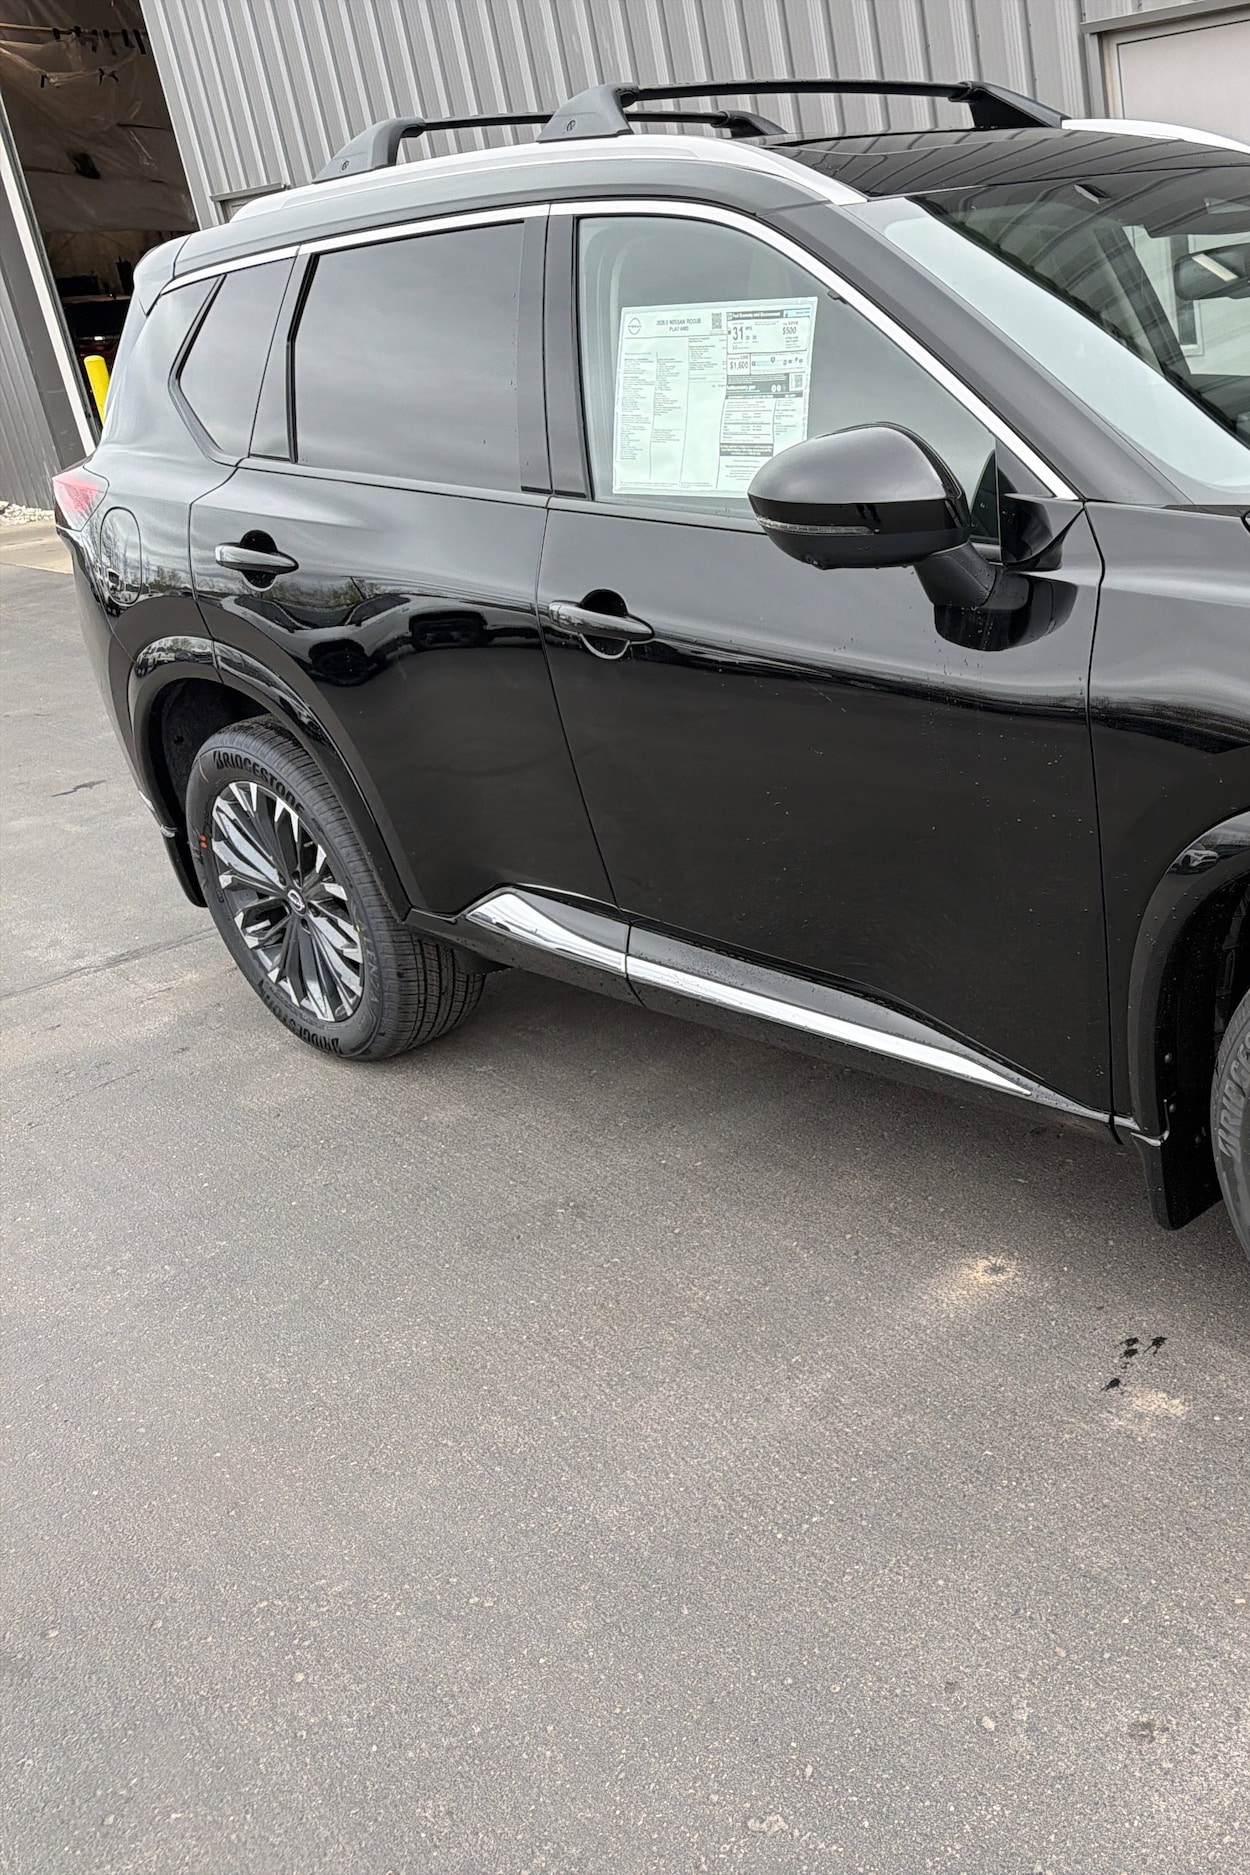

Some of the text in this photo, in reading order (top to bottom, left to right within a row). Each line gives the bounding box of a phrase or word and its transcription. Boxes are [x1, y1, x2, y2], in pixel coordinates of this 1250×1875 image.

[733, 326, 744, 340] 31
[782, 326, 797, 335] $500
[730, 361, 748, 370] $1,600
[213, 750, 305, 814] BRIDGESTONE
